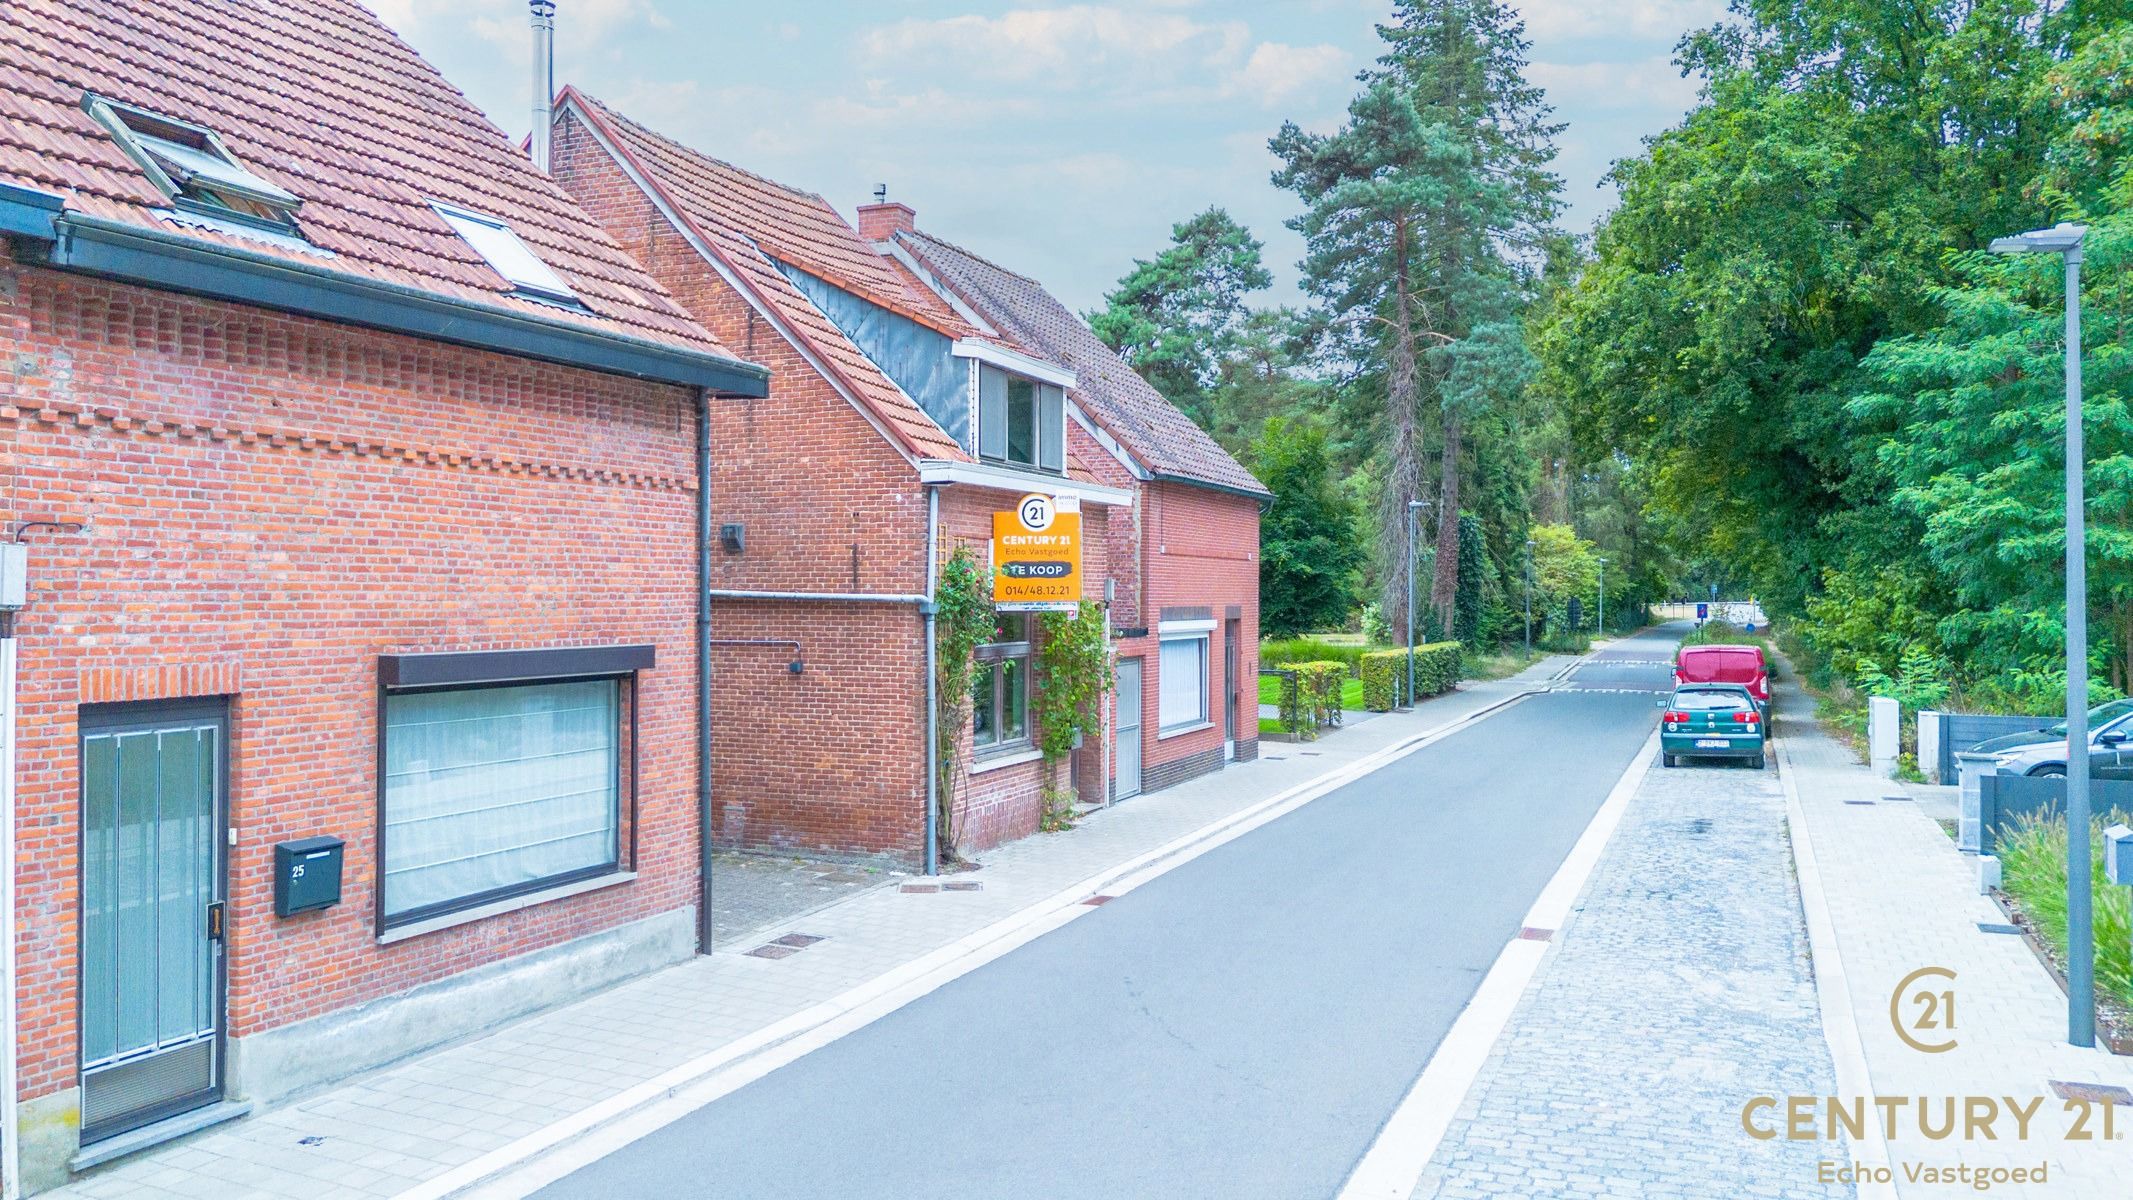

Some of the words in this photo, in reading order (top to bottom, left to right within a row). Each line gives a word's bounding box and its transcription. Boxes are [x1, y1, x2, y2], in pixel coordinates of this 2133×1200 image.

[1002, 535, 1057, 545] CENTURY
[1060, 535, 1071, 545] 21
[1005, 548, 1026, 556] Echo
[1029, 547, 1069, 557] Vastgoed
[1029, 565, 1063, 575] KOOP
[1005, 585, 1070, 596] 014/48.12.21
[292, 864, 305, 878] 25
